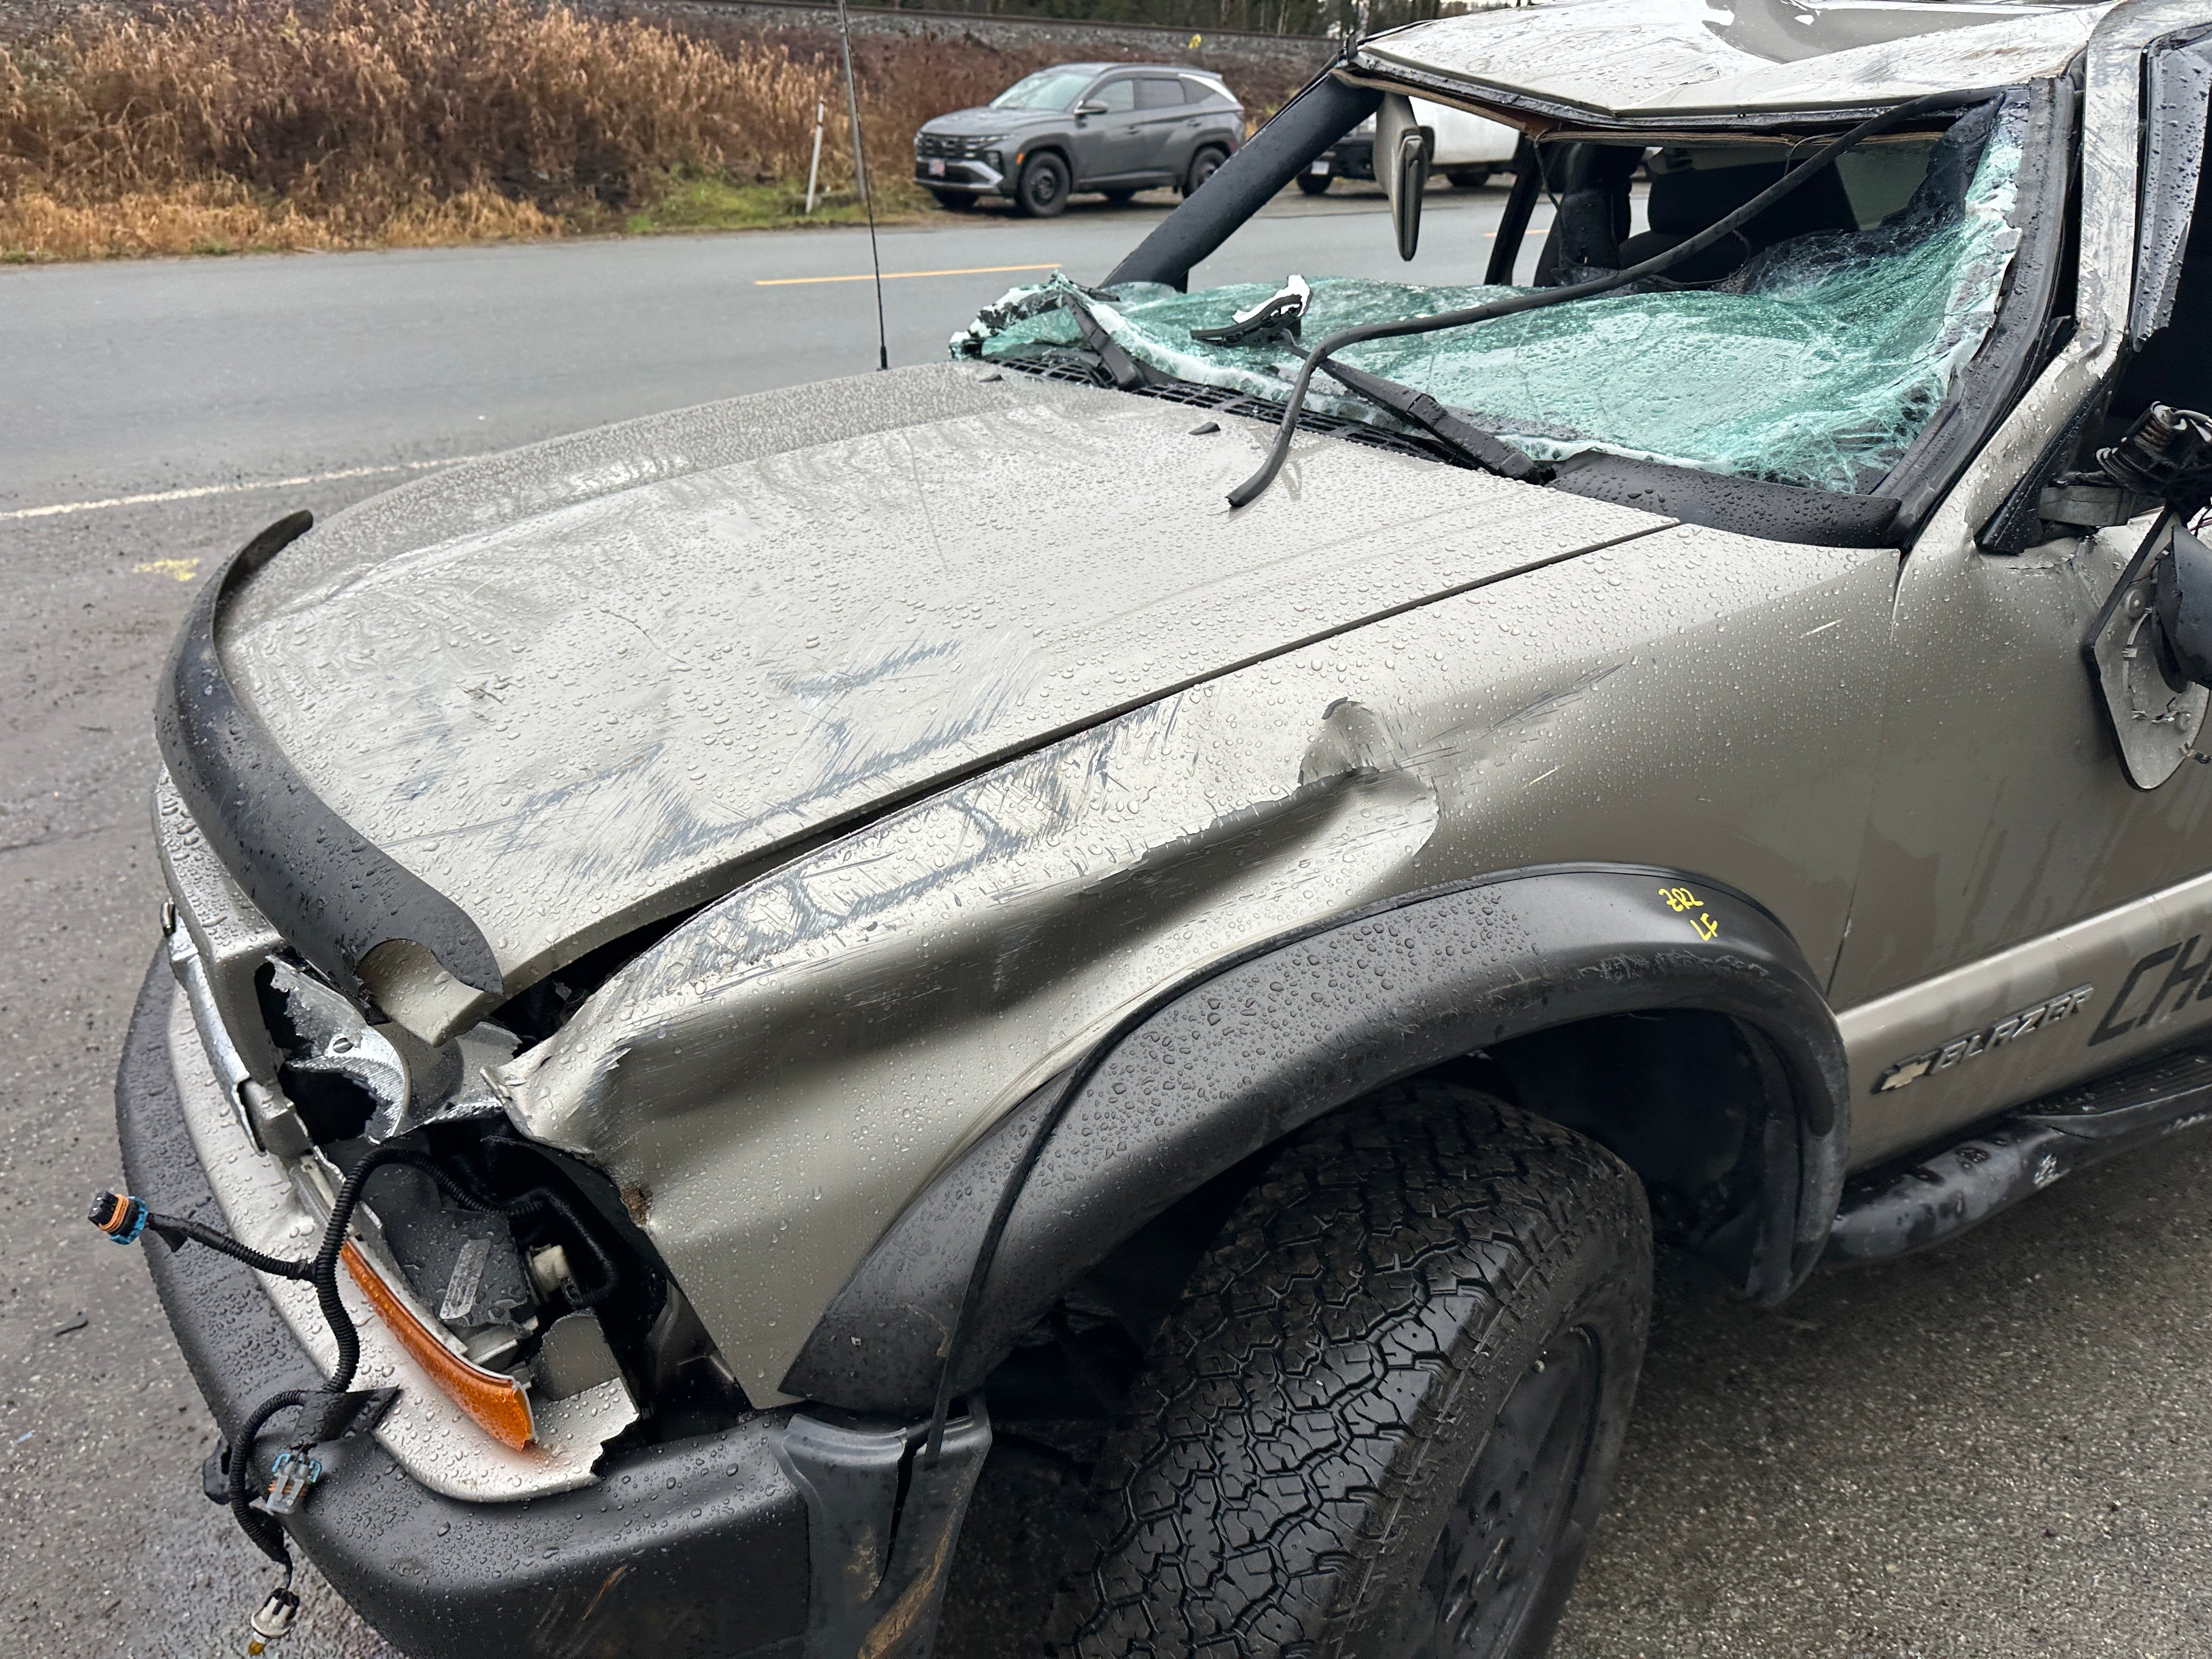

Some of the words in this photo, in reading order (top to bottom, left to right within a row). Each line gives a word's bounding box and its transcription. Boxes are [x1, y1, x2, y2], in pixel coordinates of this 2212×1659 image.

[1690, 912, 1718, 941] LF
[1928, 983, 2094, 1076] BLAZER
[2088, 933, 2212, 1047] CH
